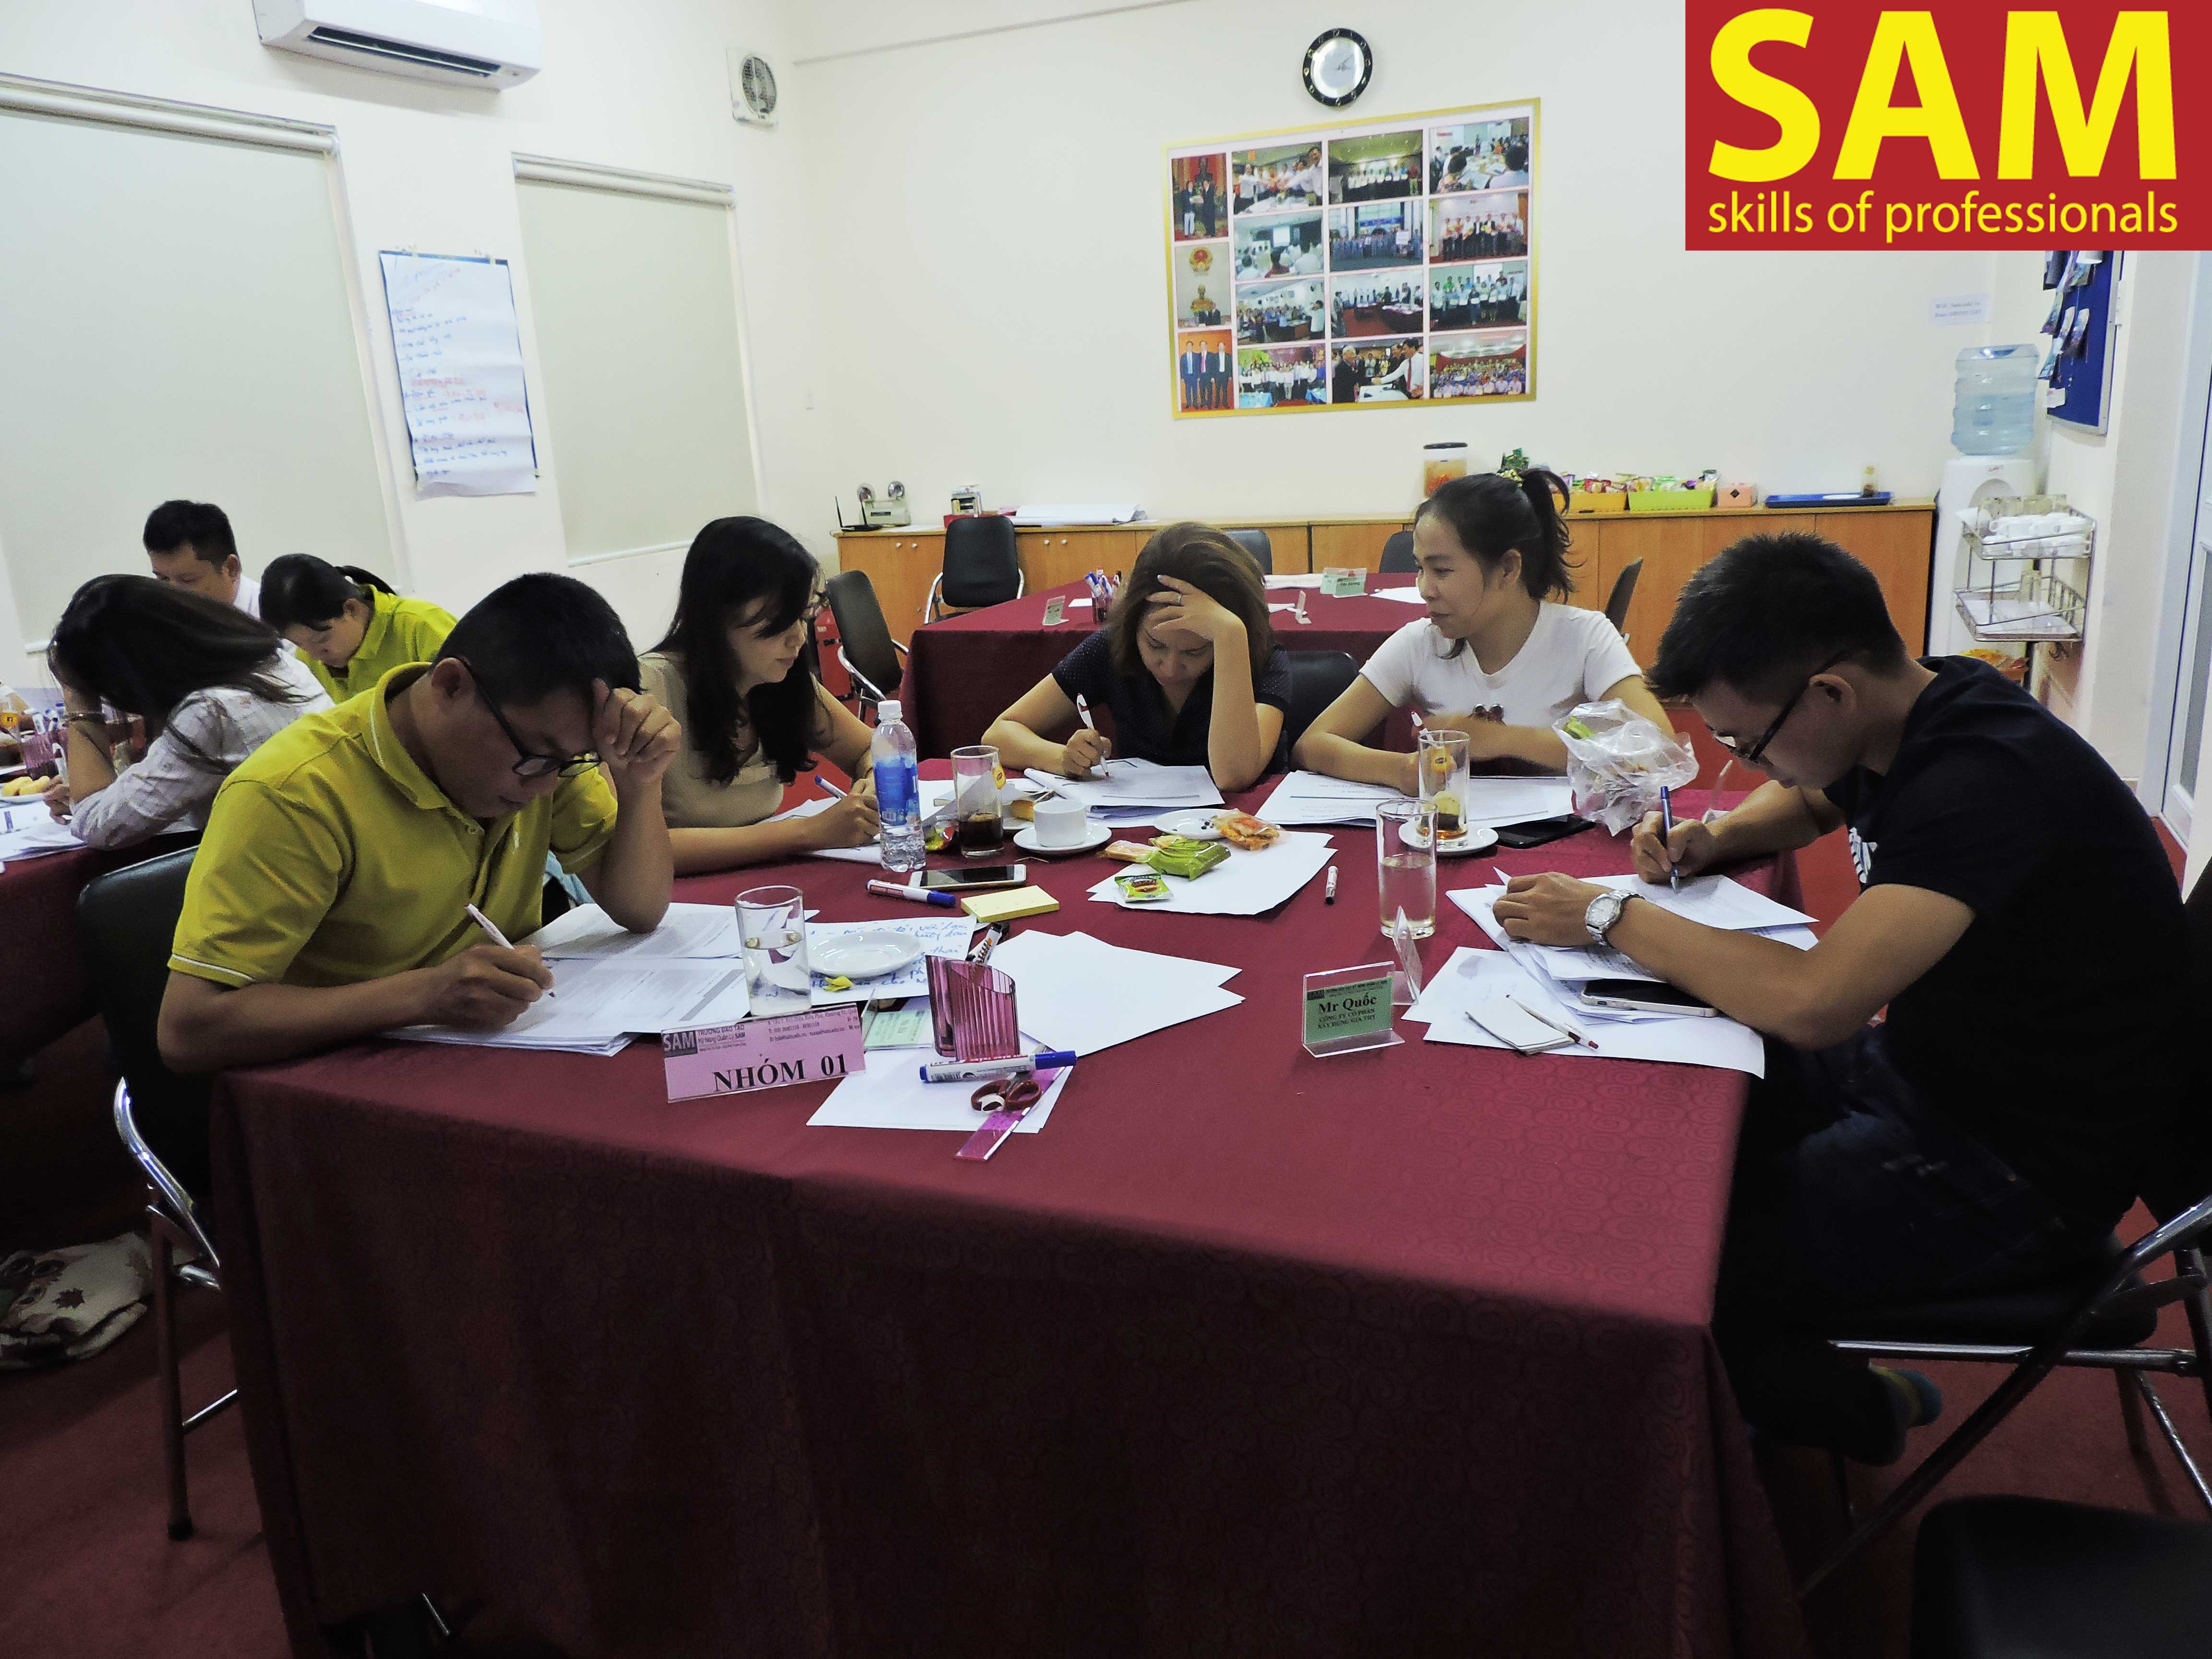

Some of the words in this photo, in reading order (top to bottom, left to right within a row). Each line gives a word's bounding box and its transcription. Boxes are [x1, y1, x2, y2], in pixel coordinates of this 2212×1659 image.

[1319, 1001, 1339, 1013] Mr
[1343, 992, 1377, 1012] Quốc
[662, 1031, 696, 1052] SAM
[713, 1058, 805, 1092] NHÓM
[821, 1054, 849, 1076] 01
